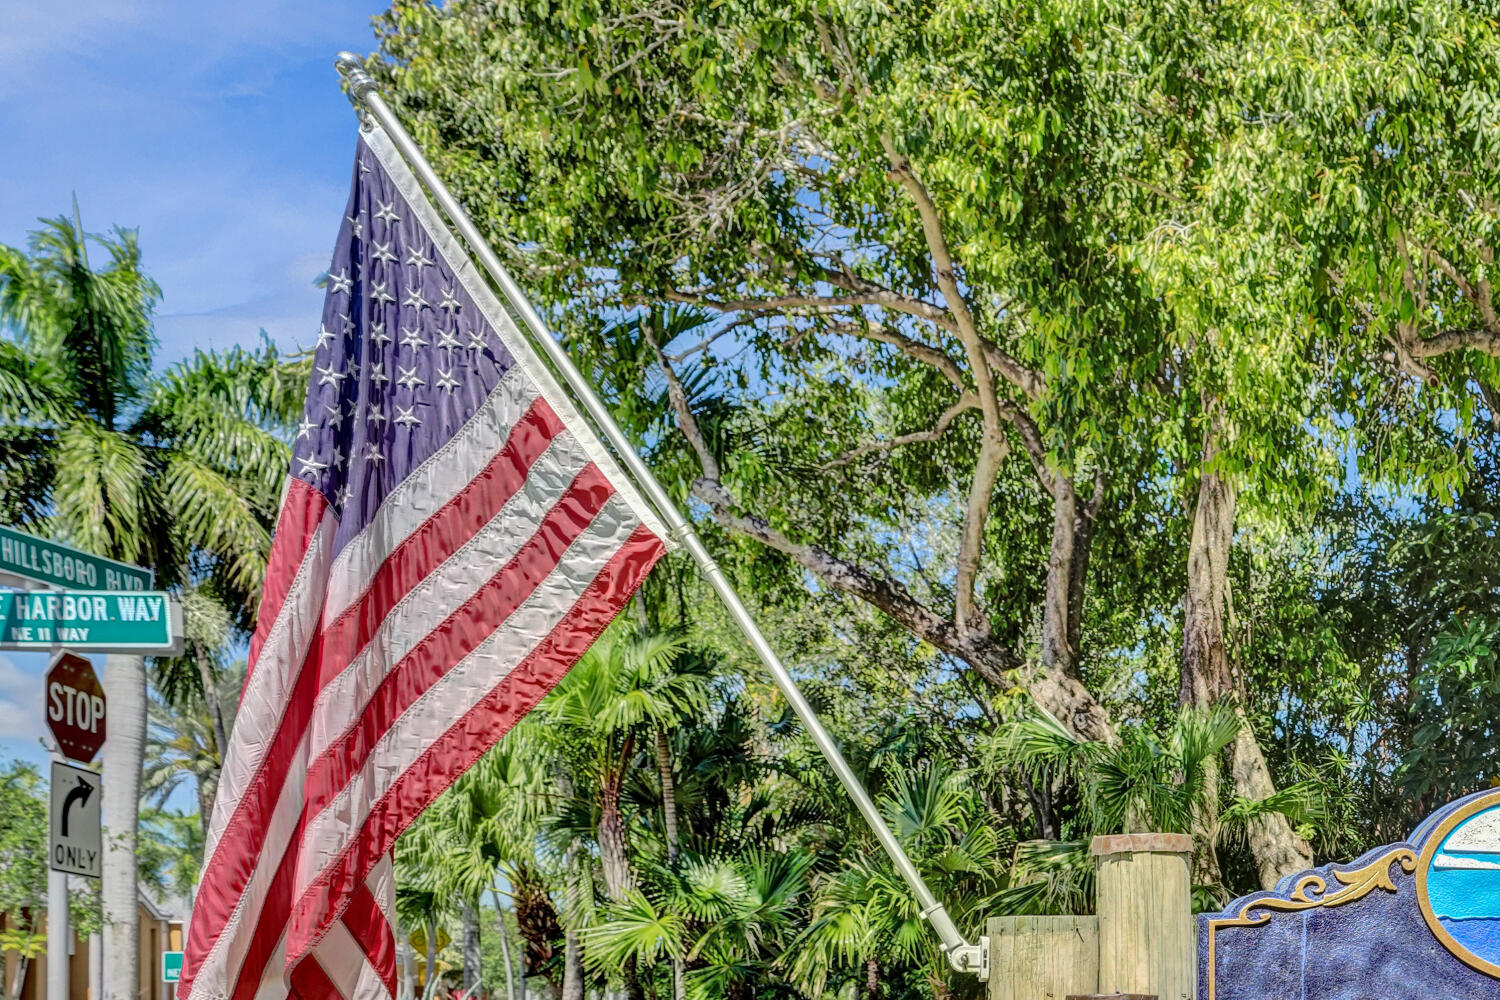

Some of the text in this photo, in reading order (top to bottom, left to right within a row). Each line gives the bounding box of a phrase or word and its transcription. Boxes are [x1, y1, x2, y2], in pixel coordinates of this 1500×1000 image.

[2, 536, 98, 588] HILLSBORO
[16, 595, 108, 621] HARBOR
[117, 596, 162, 622] WAY
[11, 627, 34, 641] NE
[57, 627, 90, 641] WAY
[49, 681, 105, 733] STOP
[55, 844, 97, 870] ONLY
